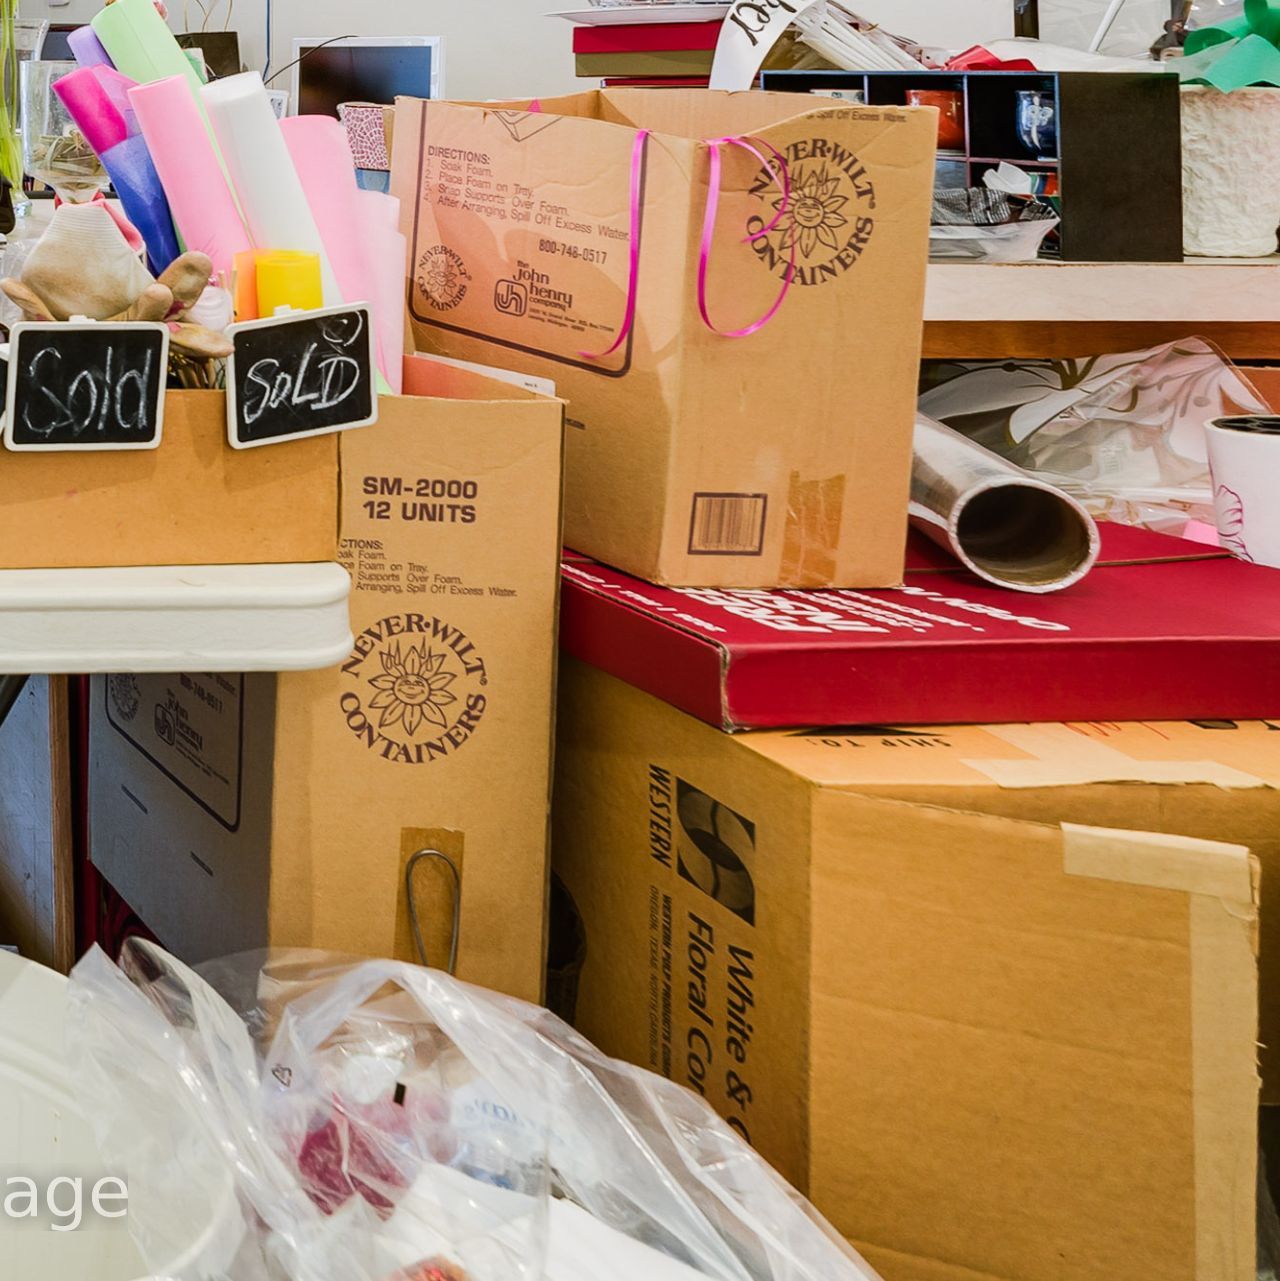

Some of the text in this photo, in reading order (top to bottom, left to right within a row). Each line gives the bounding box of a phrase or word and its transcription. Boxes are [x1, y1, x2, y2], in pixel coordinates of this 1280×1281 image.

[428, 145, 490, 165] DIRECTIONS:
[440, 159, 464, 173] Soak
[467, 163, 494, 177] Foam.
[439, 172, 462, 186] Place
[467, 176, 491, 190] Foam
[496, 183, 508, 193] on
[514, 184, 534, 199] Tray.
[438, 194, 460, 210] After
[462, 200, 507, 221] Arranging,
[511, 209, 530, 225] Spill
[535, 213, 551, 228] Off
[556, 218, 591, 234] Excess
[465, 188, 505, 205] Supports
[512, 194, 535, 210] Over
[540, 201, 569, 217] Foam.
[746, 215, 874, 286] CONTAINERS
[417, 276, 468, 312] CONTAINERS
[528, 296, 567, 312] company
[529, 281, 573, 308] henry
[362, 476, 478, 499] SM-2000
[362, 501, 477, 523] 12 UNITS
[340, 538, 383, 550] CTIONS:
[358, 551, 387, 560] Foam.
[357, 571, 400, 583] Supports
[407, 573, 429, 583] Over
[434, 574, 463, 585] Foam.
[358, 561, 385, 571] Foam
[408, 562, 428, 574] Tray.
[355, 582, 517, 597] Arranging, Spill Off Excess Water.
[340, 691, 487, 765] CONTAINERS
[880, 738, 951, 747] SHIP
[648, 763, 672, 869] WESTERN
[662, 894, 672, 947] WESTERN
[687, 910, 715, 1027] Floral
[726, 943, 755, 1064] White
[726, 1069, 753, 1112] &
